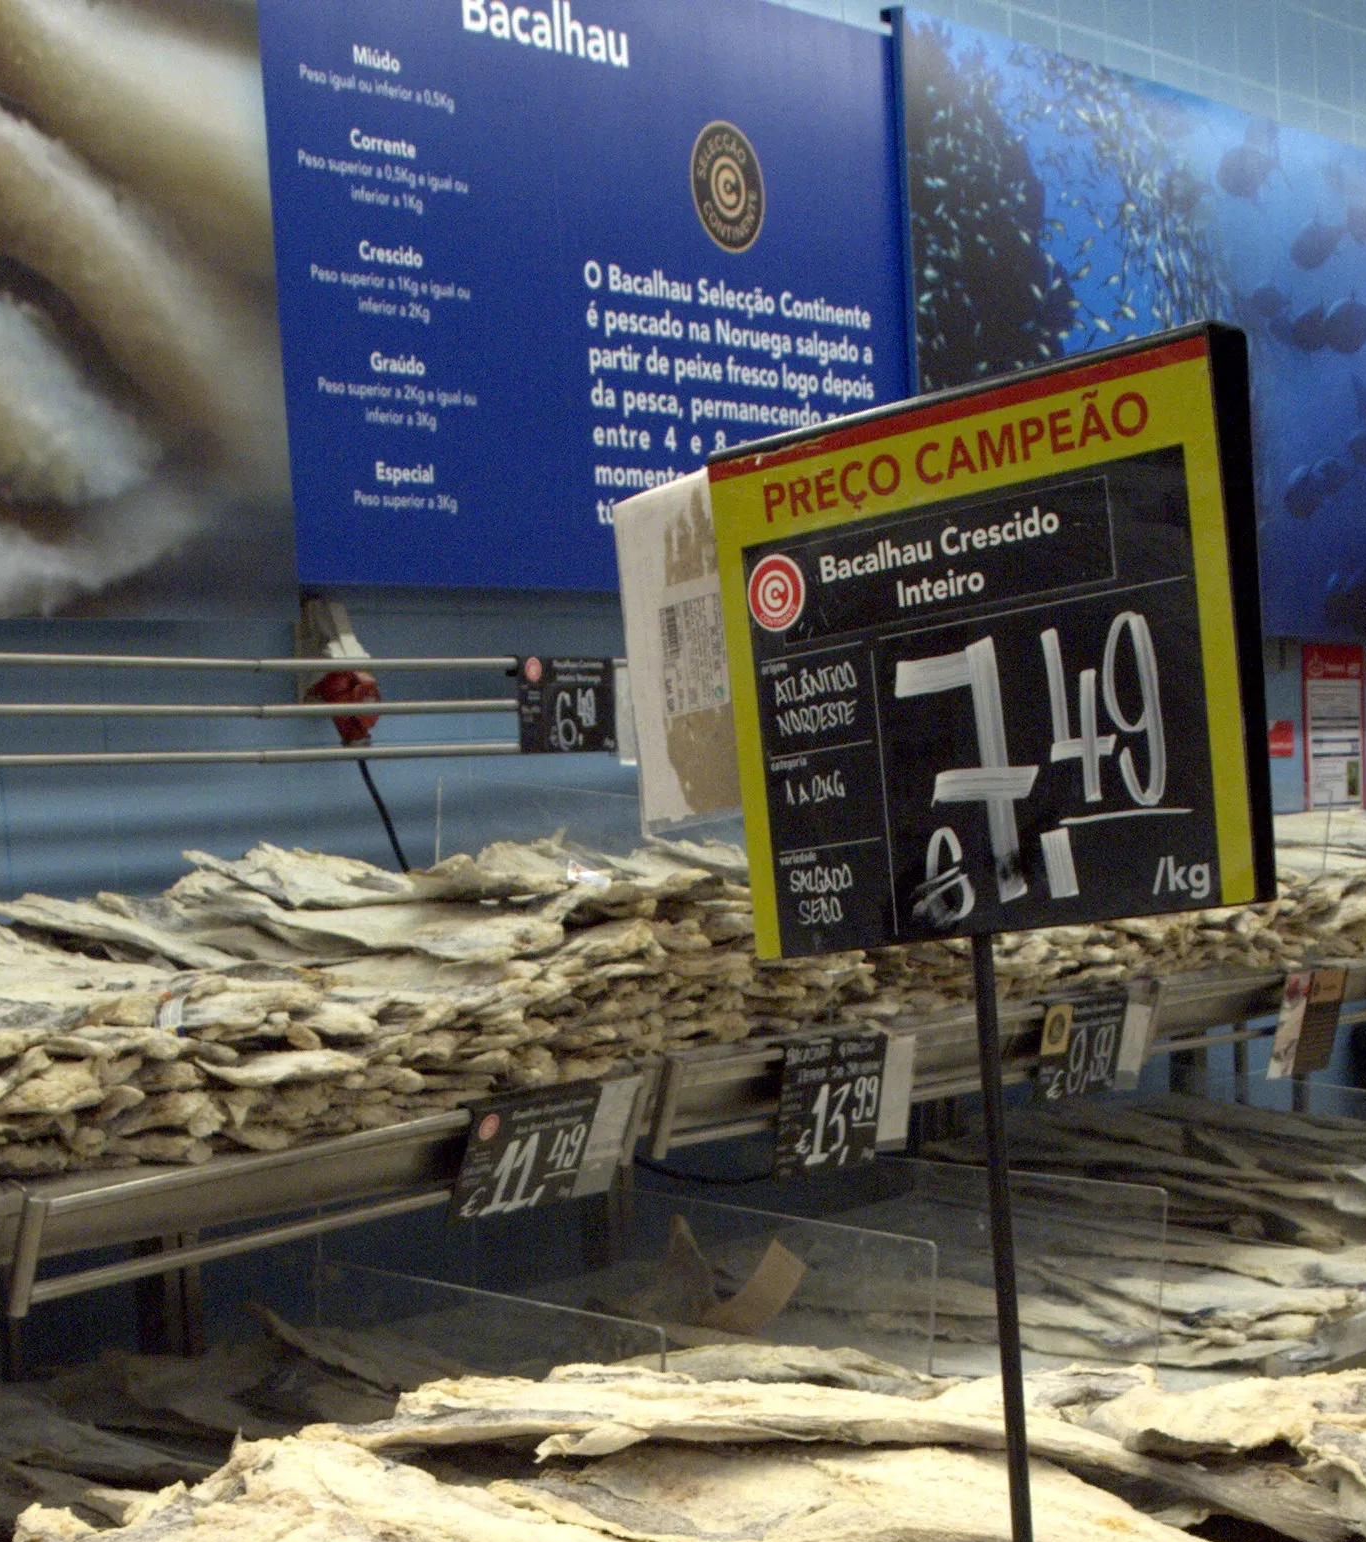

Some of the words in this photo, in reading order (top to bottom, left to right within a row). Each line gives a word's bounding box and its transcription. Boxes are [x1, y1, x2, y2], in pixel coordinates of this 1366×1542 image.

[461, 0, 629, 68] Bacalhau
[353, 44, 400, 73] Miúdo
[299, 63, 326, 84] Peso
[329, 70, 356, 91] igual
[358, 80, 372, 93] ou
[375, 80, 412, 101] inferior
[415, 91, 422, 103] a
[350, 127, 416, 159] Corrente
[298, 148, 325, 169] Peso
[327, 157, 373, 177] superior
[376, 167, 382, 179] a
[418, 173, 425, 186] e
[427, 170, 452, 192] igual
[454, 180, 468, 194] ou
[351, 184, 390, 206] inferior
[393, 196, 399, 207] a
[403, 192, 423, 215] 1Kg
[358, 240, 424, 269] Crescido
[310, 263, 338, 284] Peso
[340, 270, 385, 289] superior
[388, 278, 395, 290] a
[398, 275, 418, 298] 1Kg
[421, 282, 427, 295] e
[430, 279, 455, 301] igual
[457, 287, 471, 300] ou
[584, 260, 601, 288] O
[608, 264, 692, 302] Bacalhau
[698, 278, 775, 318] Selecção
[780, 291, 871, 329] Continente
[358, 296, 397, 316] inferior
[399, 305, 406, 317] a
[408, 302, 430, 325] 2Kg
[586, 300, 598, 328] é
[604, 309, 683, 339] pescado
[688, 321, 710, 343] na
[715, 318, 791, 359] Noruega
[796, 331, 859, 366] salgado
[863, 346, 873, 364] a
[370, 351, 426, 376] Graúdo
[588, 345, 640, 373] partir
[645, 346, 669, 375] de
[675, 354, 722, 384] peixe
[726, 355, 778, 388] fresco
[782, 363, 819, 399] logo
[822, 369, 875, 402] depois
[317, 376, 346, 395] Peso
[347, 382, 392, 400] superior
[395, 388, 402, 399] a
[404, 384, 425, 406] 2Kg
[427, 391, 434, 402] e
[437, 387, 461, 408] igual
[463, 394, 477, 406] ou
[590, 378, 616, 408] da
[623, 390, 684, 418] pesca,
[691, 396, 822, 427] permanecendo
[365, 406, 403, 425] inferior
[593, 426, 650, 450] entre
[664, 426, 676, 452] 4
[691, 434, 701, 454] e
[762, 453, 901, 524] PREÇO
[915, 390, 1148, 484] CAMPEÃO
[375, 461, 434, 487] Especial
[353, 489, 380, 507] Peso
[383, 493, 425, 512] superior
[819, 539, 932, 584] Bacalhau
[940, 506, 1059, 556] Crescido
[896, 569, 984, 608] Inteiro
[776, 700, 858, 736] NORDESTE
[1152, 855, 1211, 899] /kg
[798, 896, 844, 926] SECO
